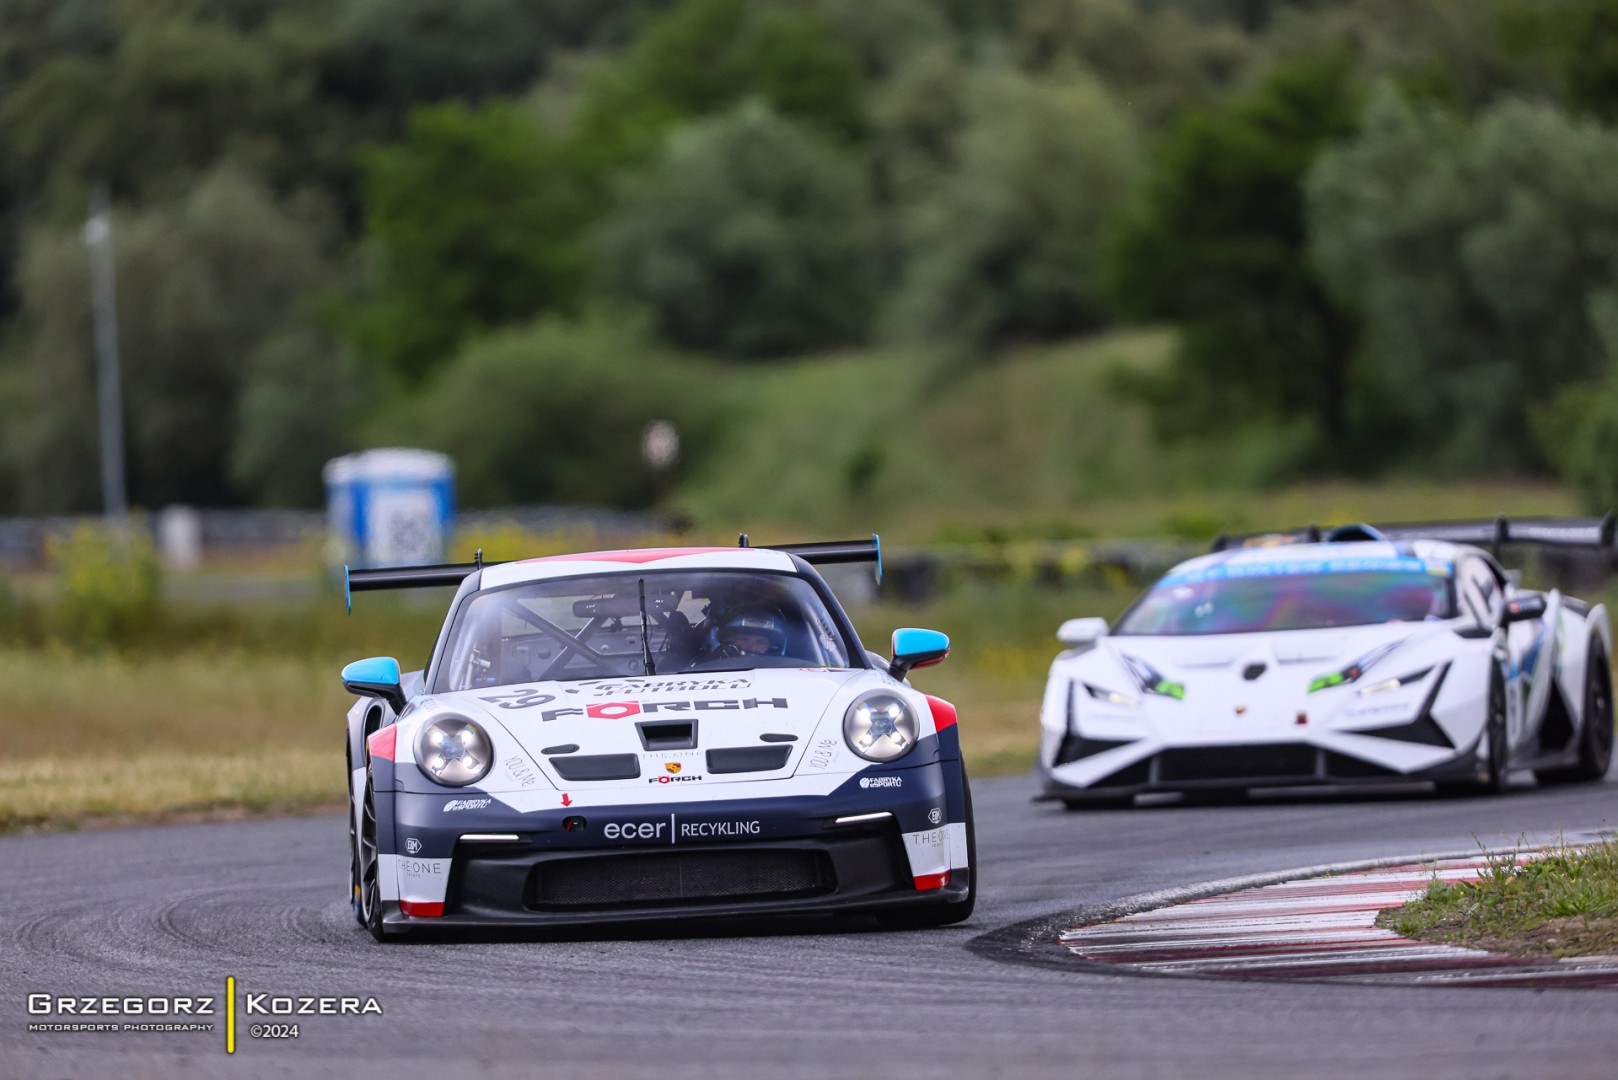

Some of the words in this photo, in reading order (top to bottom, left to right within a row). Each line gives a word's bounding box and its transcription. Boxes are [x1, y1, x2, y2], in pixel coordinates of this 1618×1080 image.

[478, 688, 556, 709] 29
[604, 822, 666, 839] ecer
[681, 821, 760, 837] RECYKLING
[913, 832, 937, 845] THE
[412, 861, 441, 874] ONE
